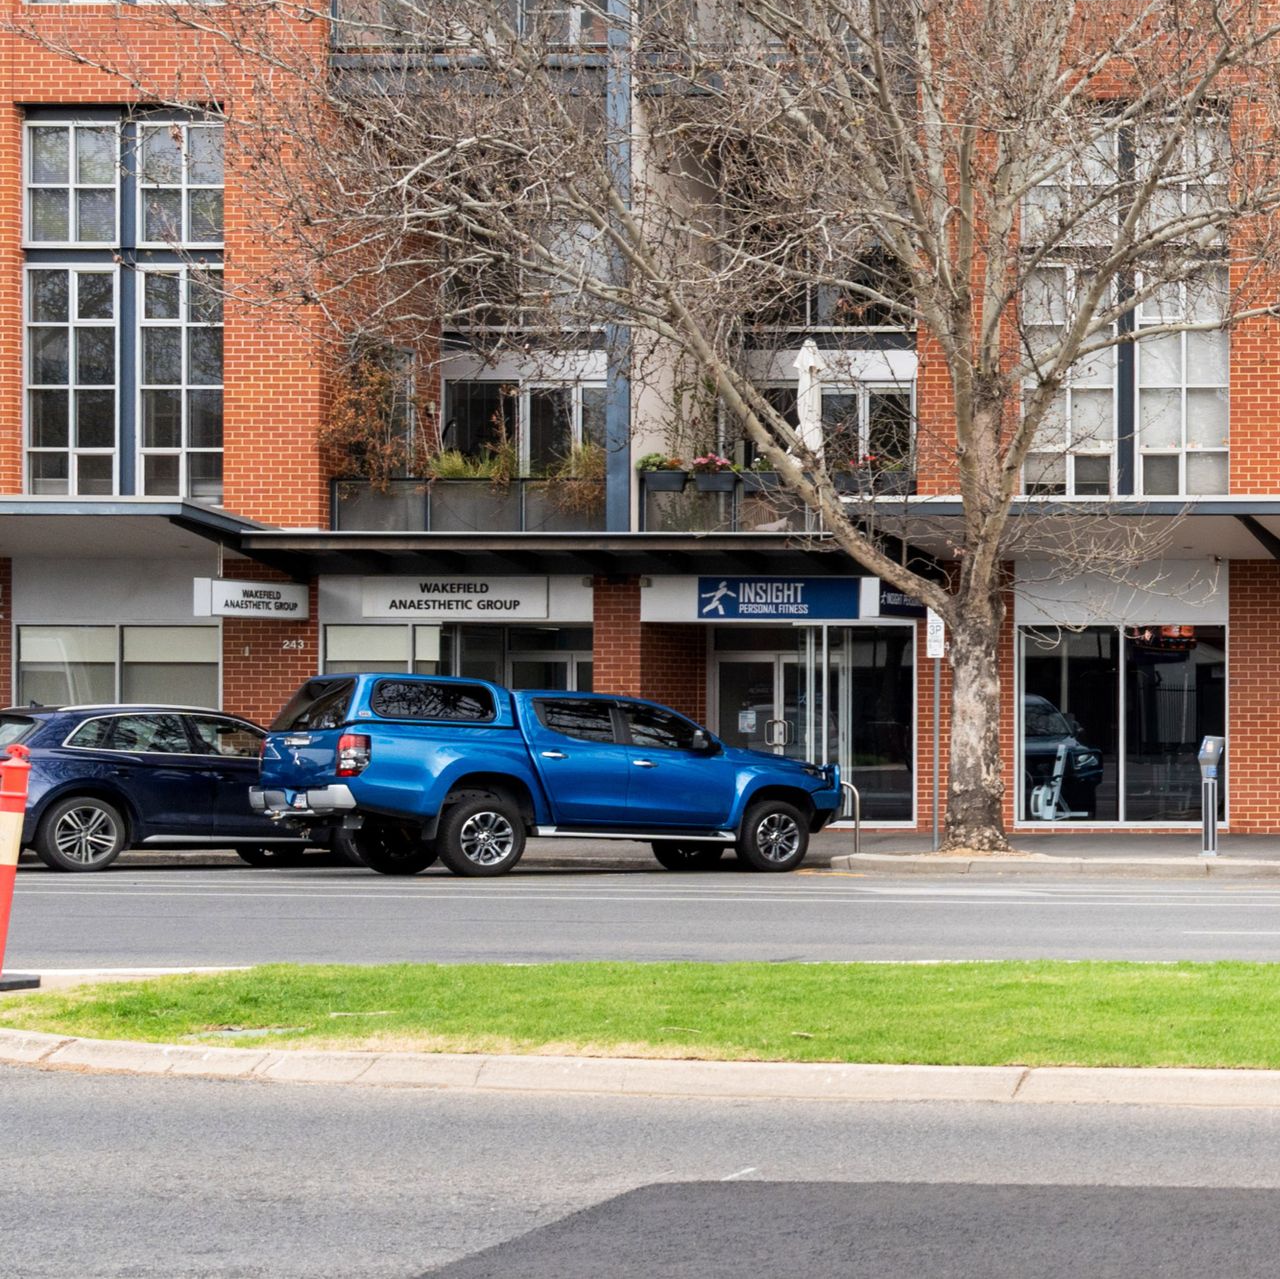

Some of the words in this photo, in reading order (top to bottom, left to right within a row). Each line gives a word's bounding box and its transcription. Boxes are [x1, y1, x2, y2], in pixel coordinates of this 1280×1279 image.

[419, 582, 489, 594] WAKEFIELD
[739, 583, 805, 603] INSIGHT
[242, 589, 281, 600] WAKEFIELD
[224, 599, 272, 610] ANAESTHETIC
[274, 601, 298, 611] GROUP
[389, 599, 473, 610] ANAESTHETIC
[477, 599, 521, 610] GROUP
[739, 604, 777, 614] PERSONAL
[779, 604, 809, 614] FITNESS
[929, 624, 942, 635] 3P
[282, 639, 304, 649] 243
